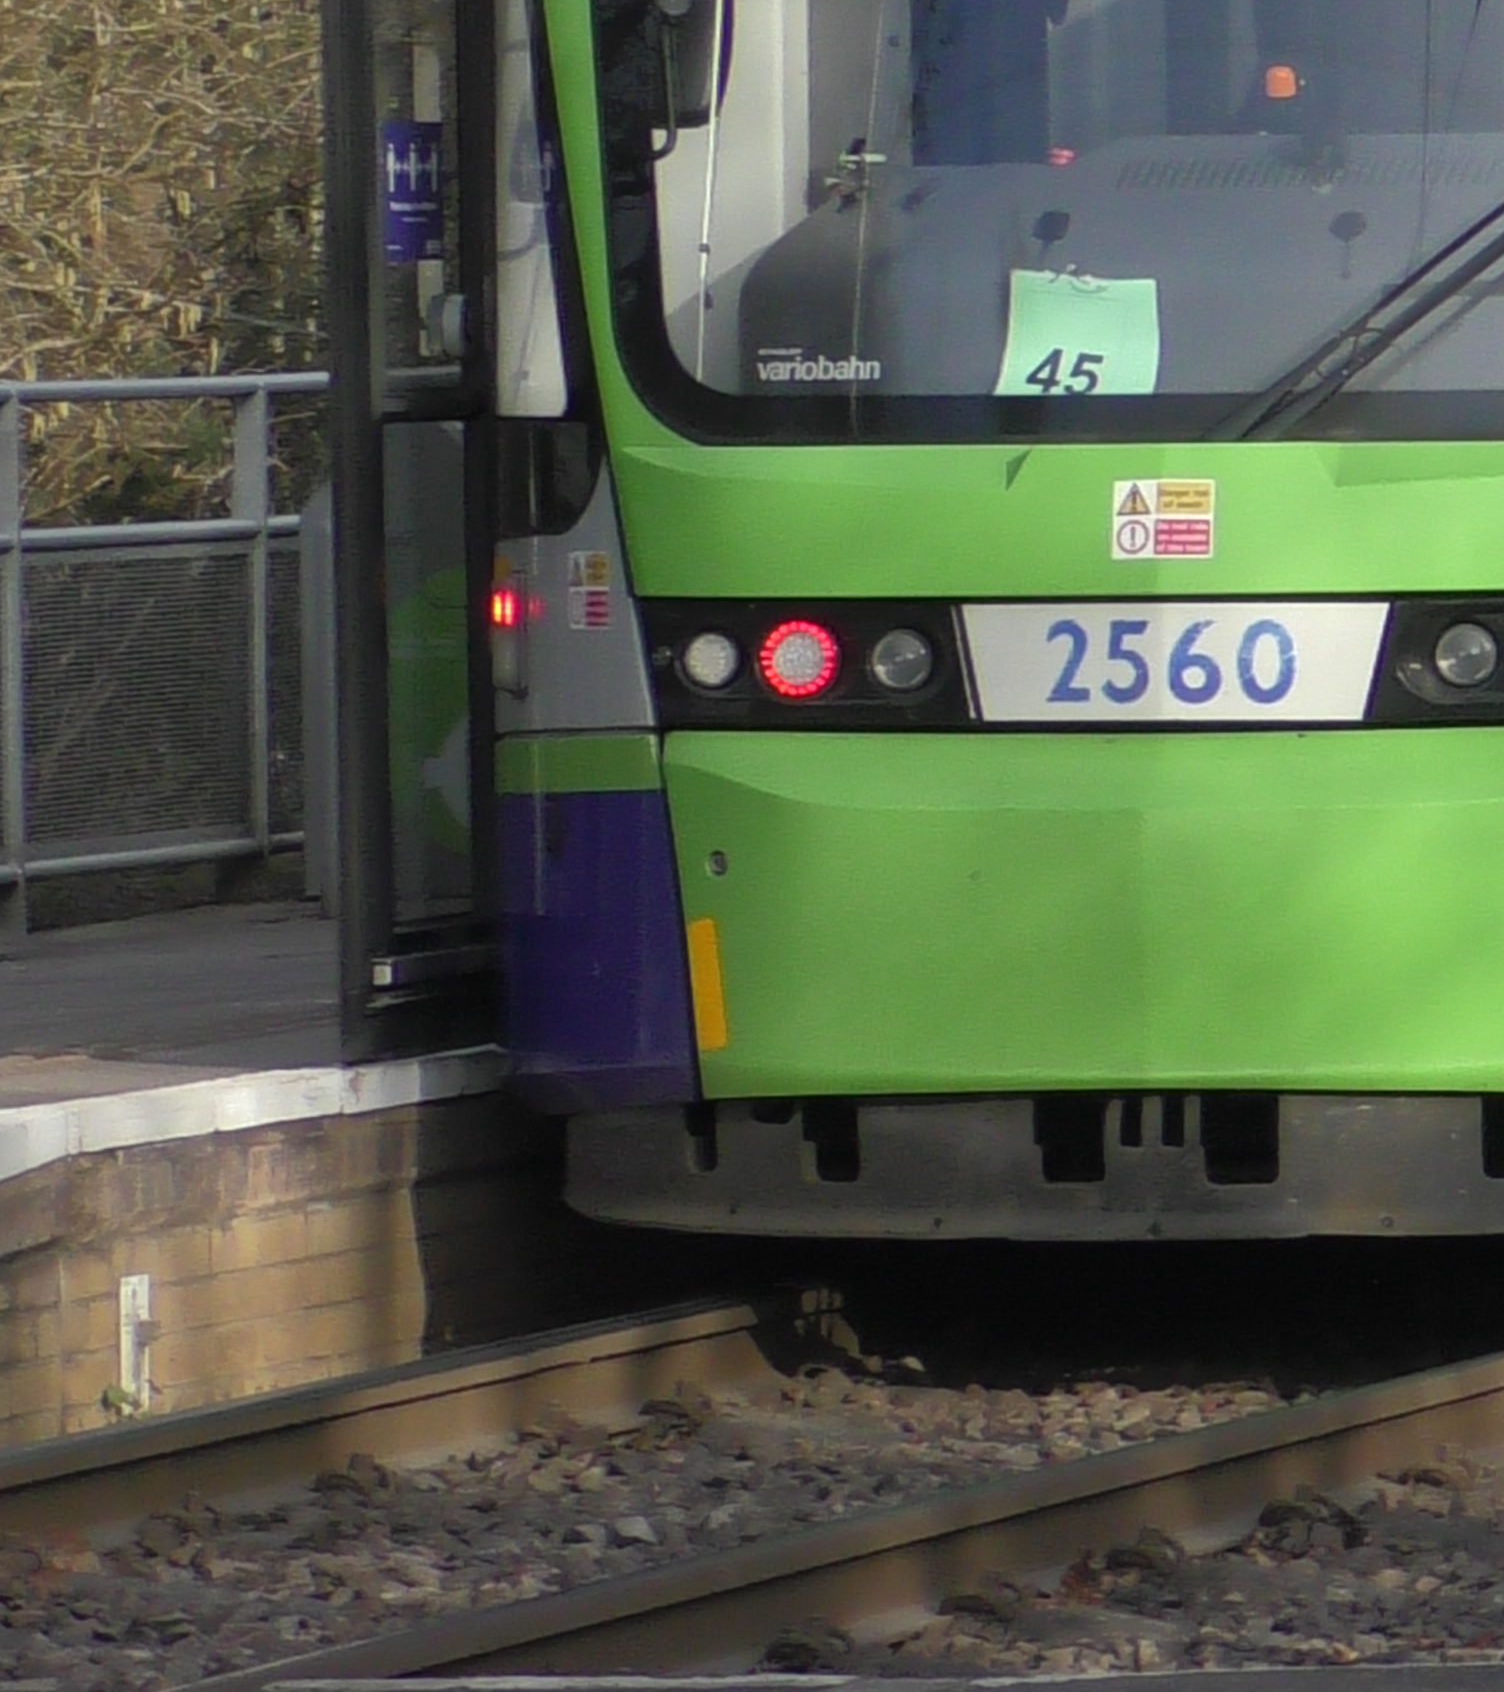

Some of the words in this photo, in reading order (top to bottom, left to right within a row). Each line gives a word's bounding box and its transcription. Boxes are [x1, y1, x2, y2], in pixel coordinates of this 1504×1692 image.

[757, 355, 881, 381] variobahn
[1026, 348, 1104, 394] 45
[1046, 619, 1296, 704] 2560
